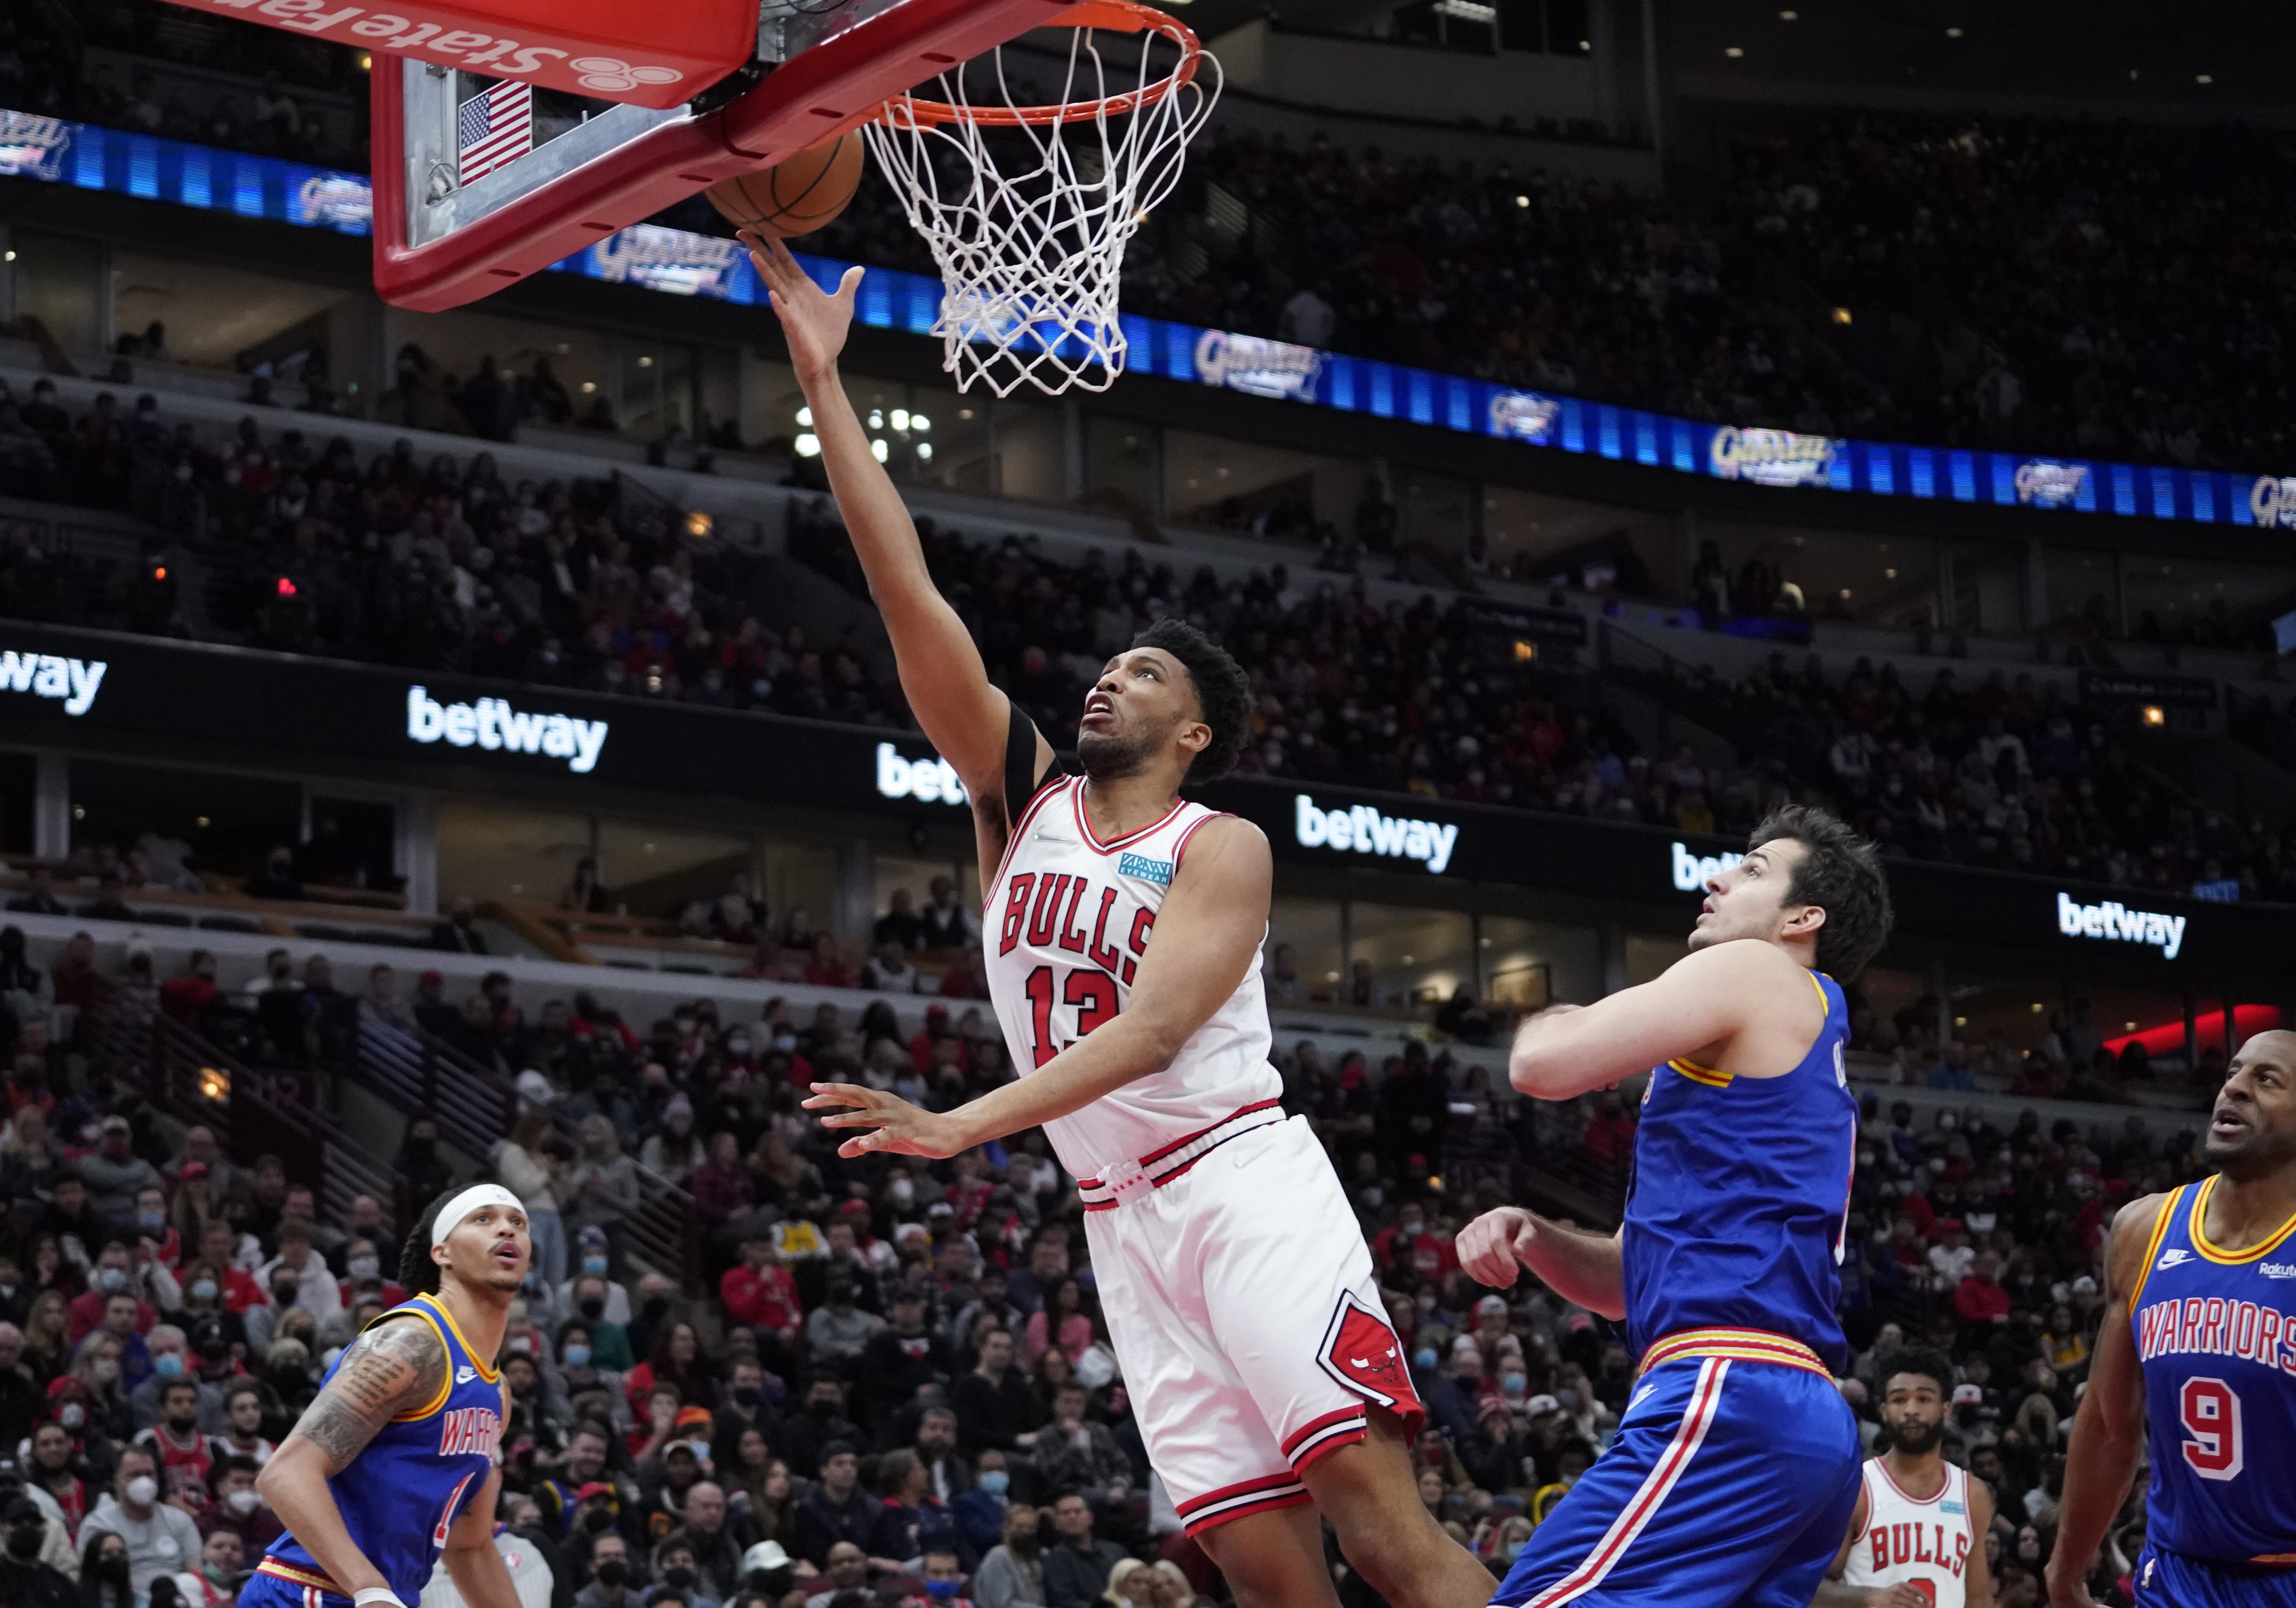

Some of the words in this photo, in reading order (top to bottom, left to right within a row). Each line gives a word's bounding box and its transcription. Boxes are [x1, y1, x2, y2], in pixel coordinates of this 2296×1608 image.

[407, 685, 608, 773] betway
[876, 742, 971, 807] bet
[1123, 854, 1171, 875] ZENNI
[1295, 794, 1459, 873] betway
[1120, 867, 1167, 884] EYEWEAR
[2057, 892, 2186, 960] betway
[2259, 1262, 2296, 1276] Rakut
[2180, 1376, 2244, 1481] 9
[1870, 1522, 1968, 1578] BULLS
